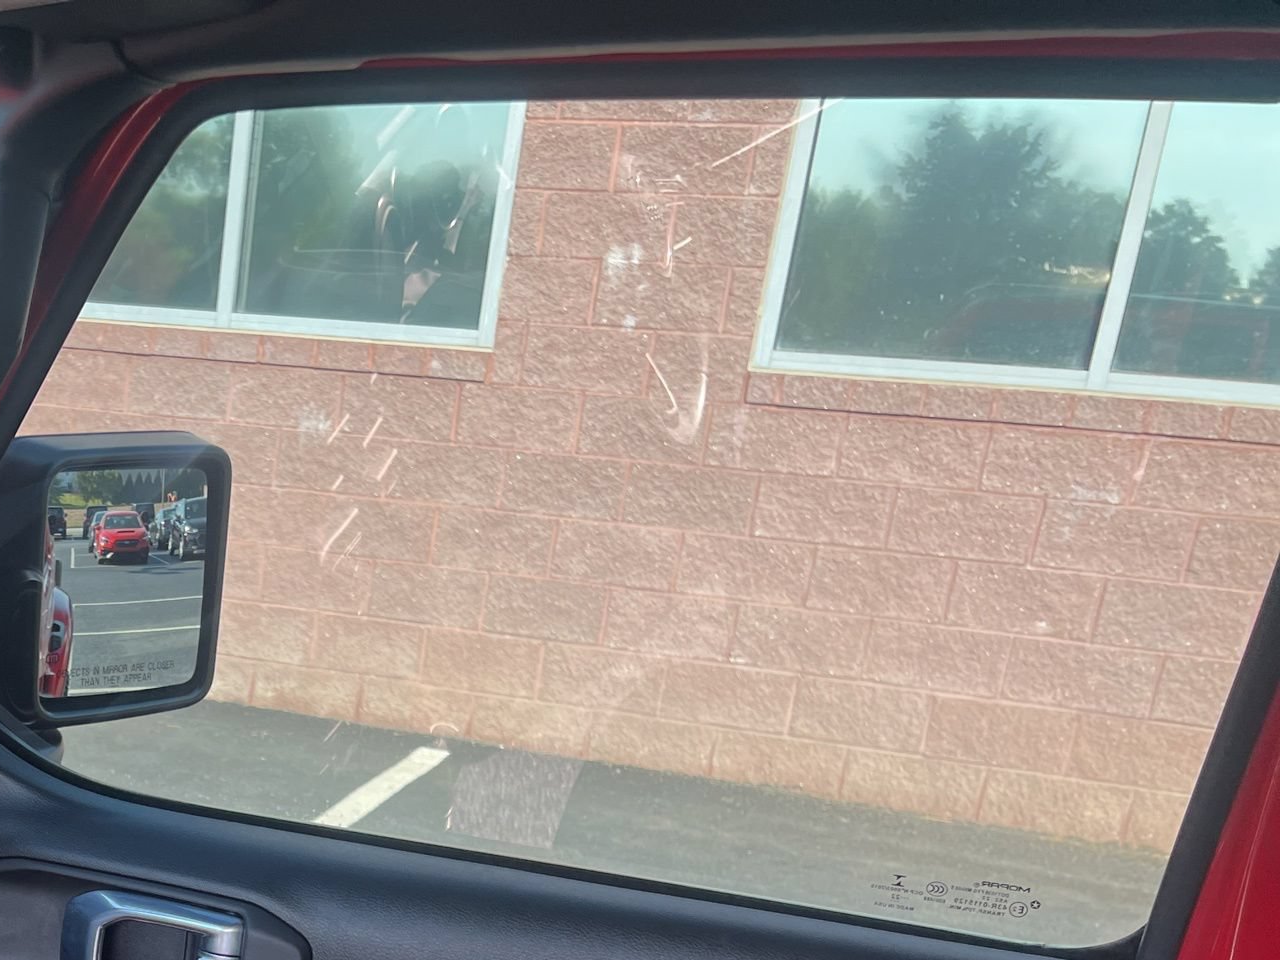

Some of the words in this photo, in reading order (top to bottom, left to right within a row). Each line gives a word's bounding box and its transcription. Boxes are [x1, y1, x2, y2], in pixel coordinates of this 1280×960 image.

[102, 664, 128, 674] MIRROR
[131, 663, 145, 672] ARE
[147, 660, 175, 671] CLOSER
[81, 677, 100, 687] THAN
[103, 674, 120, 684] THEY
[124, 673, 152, 682] APPEAR
